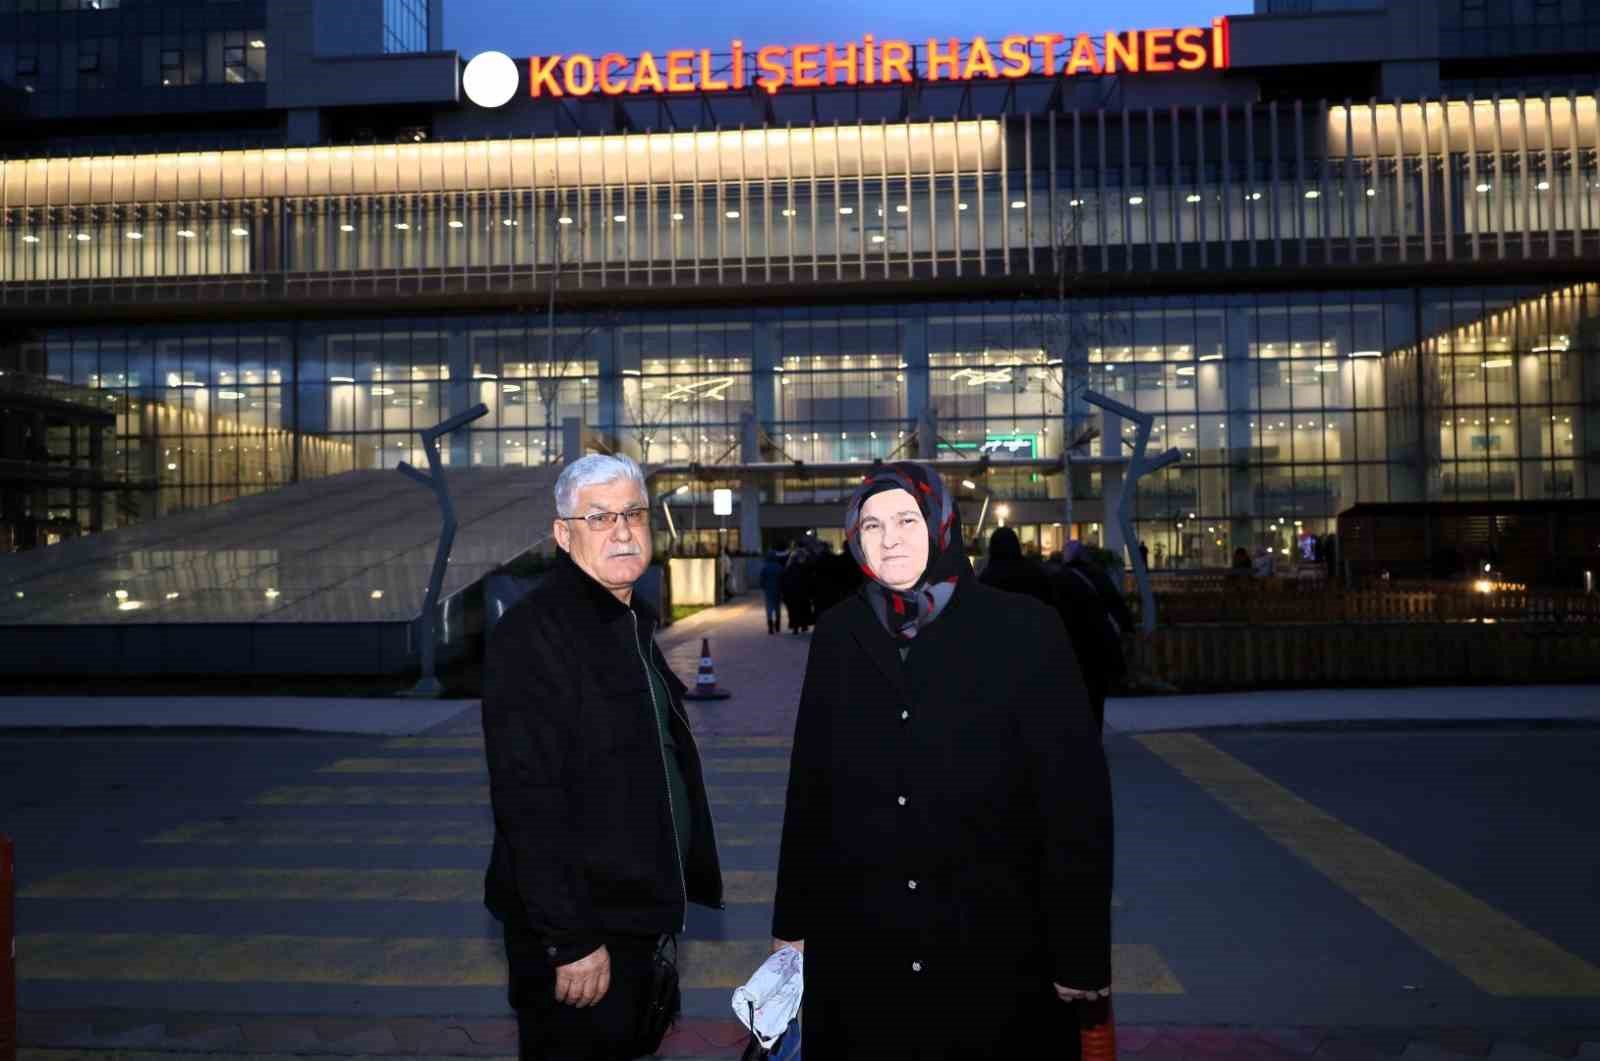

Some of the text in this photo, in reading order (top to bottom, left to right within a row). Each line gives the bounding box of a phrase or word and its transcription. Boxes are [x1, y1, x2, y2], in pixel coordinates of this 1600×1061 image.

[529, 15, 1229, 98] KOCAELİ ŞEHİR HASTANESİ
